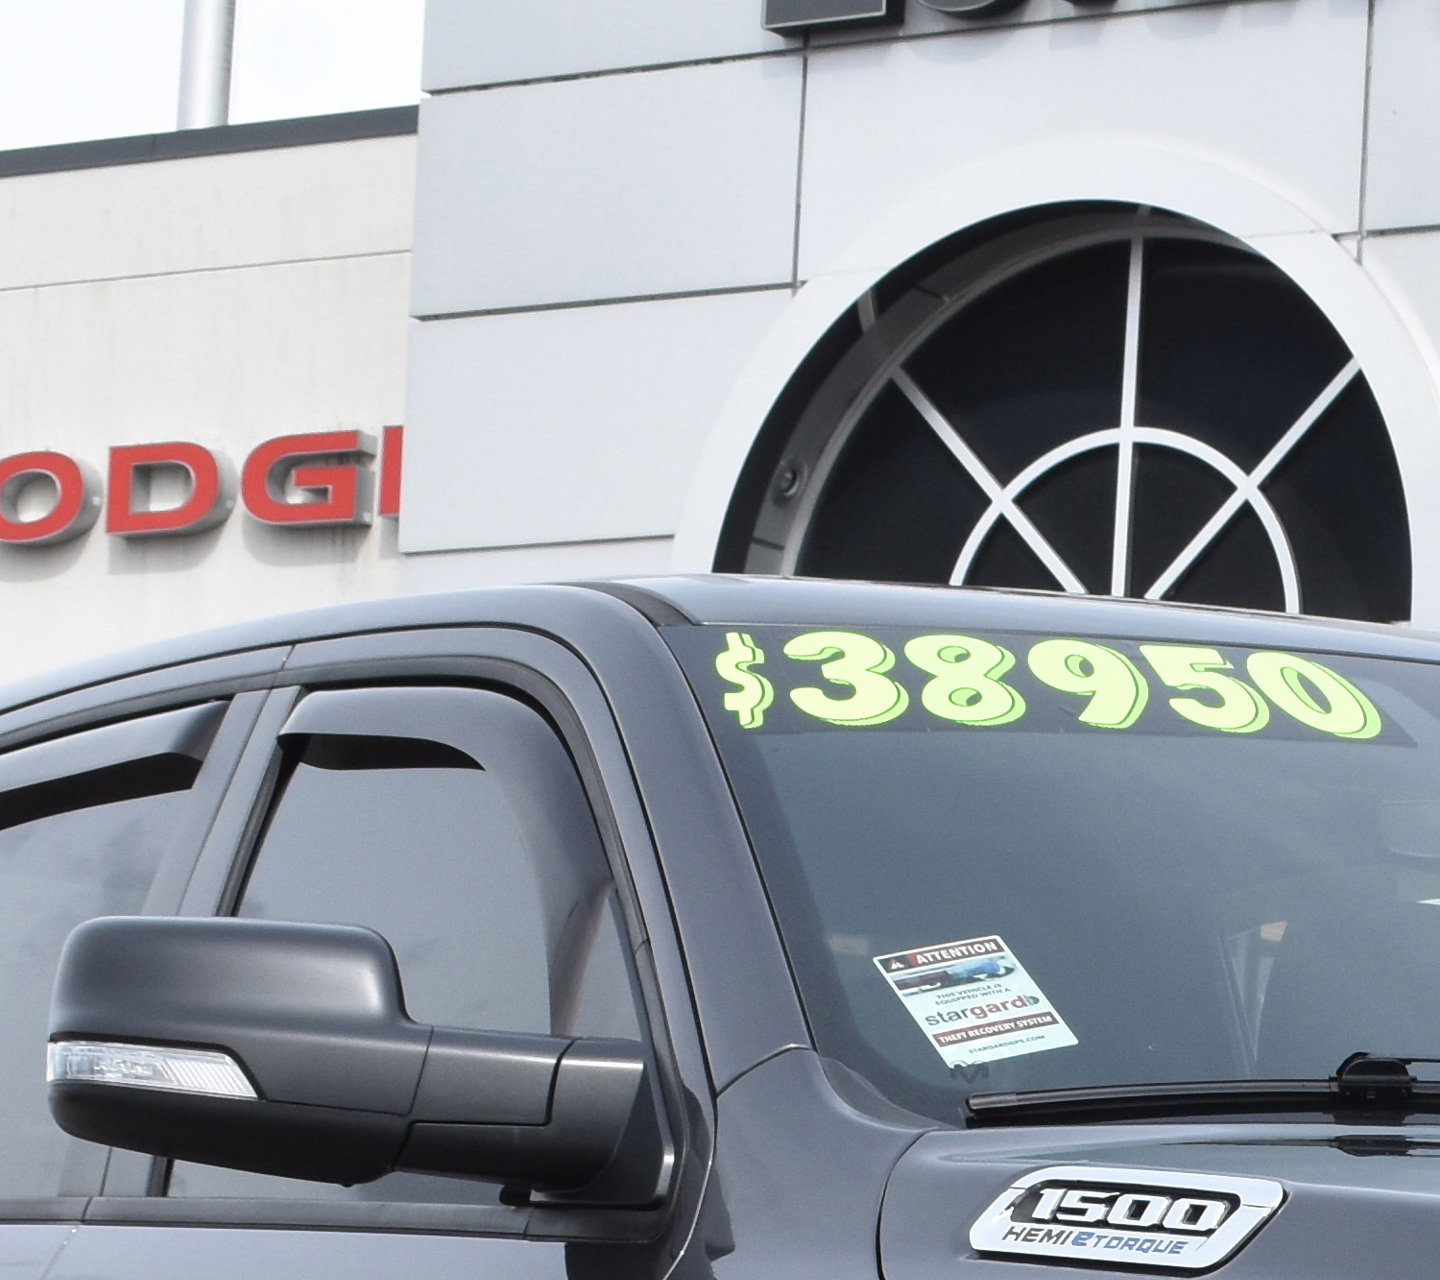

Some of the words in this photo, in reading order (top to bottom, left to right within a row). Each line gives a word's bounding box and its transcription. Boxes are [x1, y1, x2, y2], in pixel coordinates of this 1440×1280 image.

[715, 630, 1382, 738] $38950
[916, 942, 998, 965] ATTENTION
[925, 995, 1026, 1026] stargard
[938, 1031, 967, 1044] THEFT
[968, 1023, 1016, 1038] RECOVERY
[1016, 1015, 1053, 1028] SYSTEM
[1031, 1187, 1231, 1231] 1500
